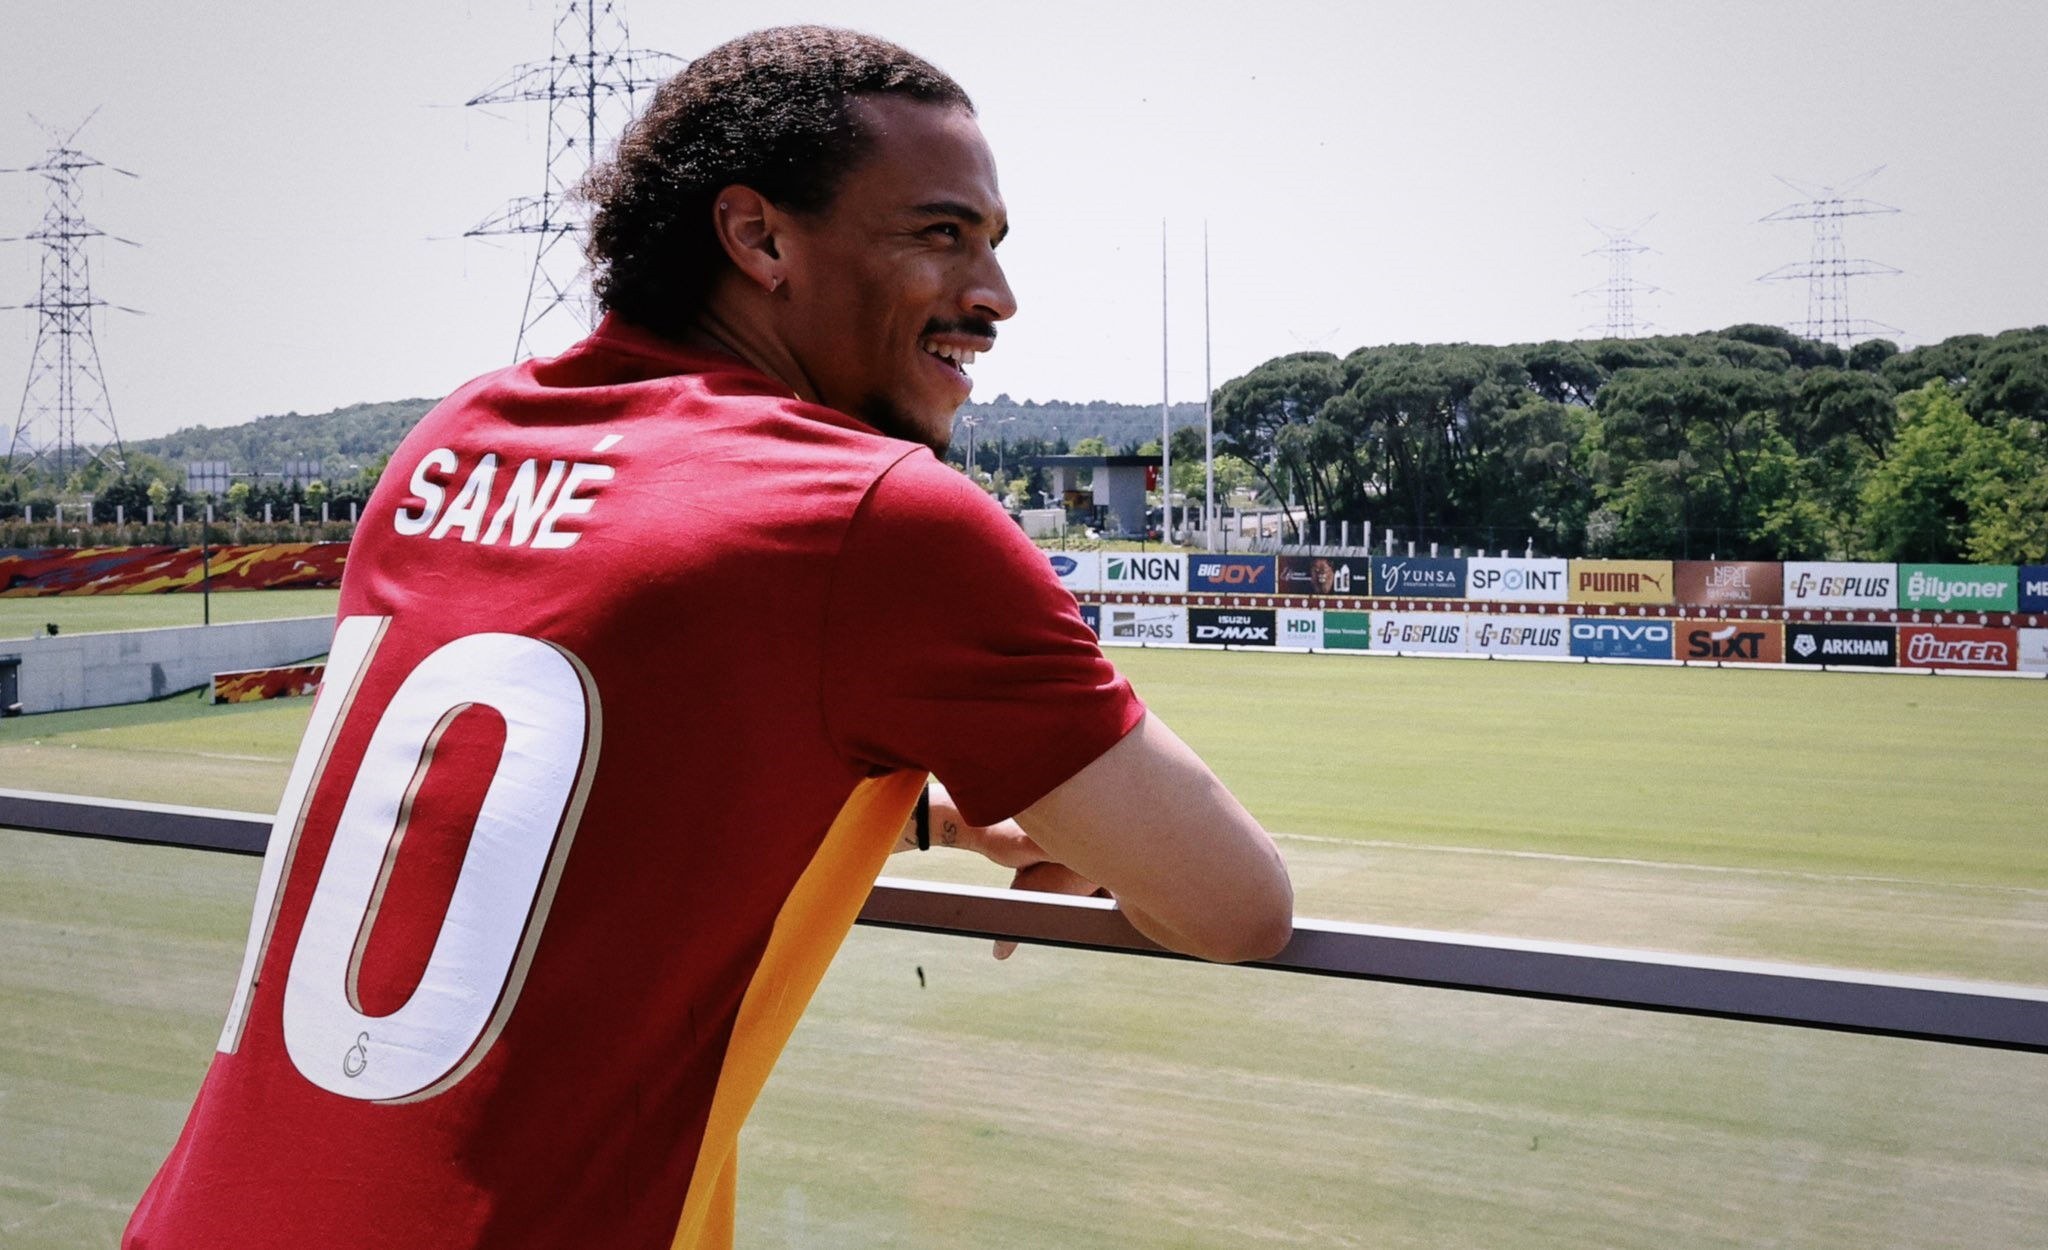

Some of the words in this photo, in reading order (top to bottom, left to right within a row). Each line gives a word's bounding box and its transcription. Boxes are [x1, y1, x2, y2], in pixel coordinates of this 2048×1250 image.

[394, 434, 623, 549] SANÉ
[1131, 558, 1180, 580] NGN
[1579, 572, 1640, 593] PUMA
[1819, 577, 1889, 597] GSPLUS
[1907, 571, 2008, 603] Bilyoner
[1218, 615, 1251, 625] ISUZU
[1287, 619, 1316, 633] HDI
[1137, 624, 1173, 638] PASS
[1402, 625, 1460, 644] GSPLUS
[1500, 626, 1561, 647] GSPLUS
[1822, 639, 1888, 655] ARKHAM
[1907, 633, 2008, 665] ÜLKER
[215, 615, 603, 1105] 10
